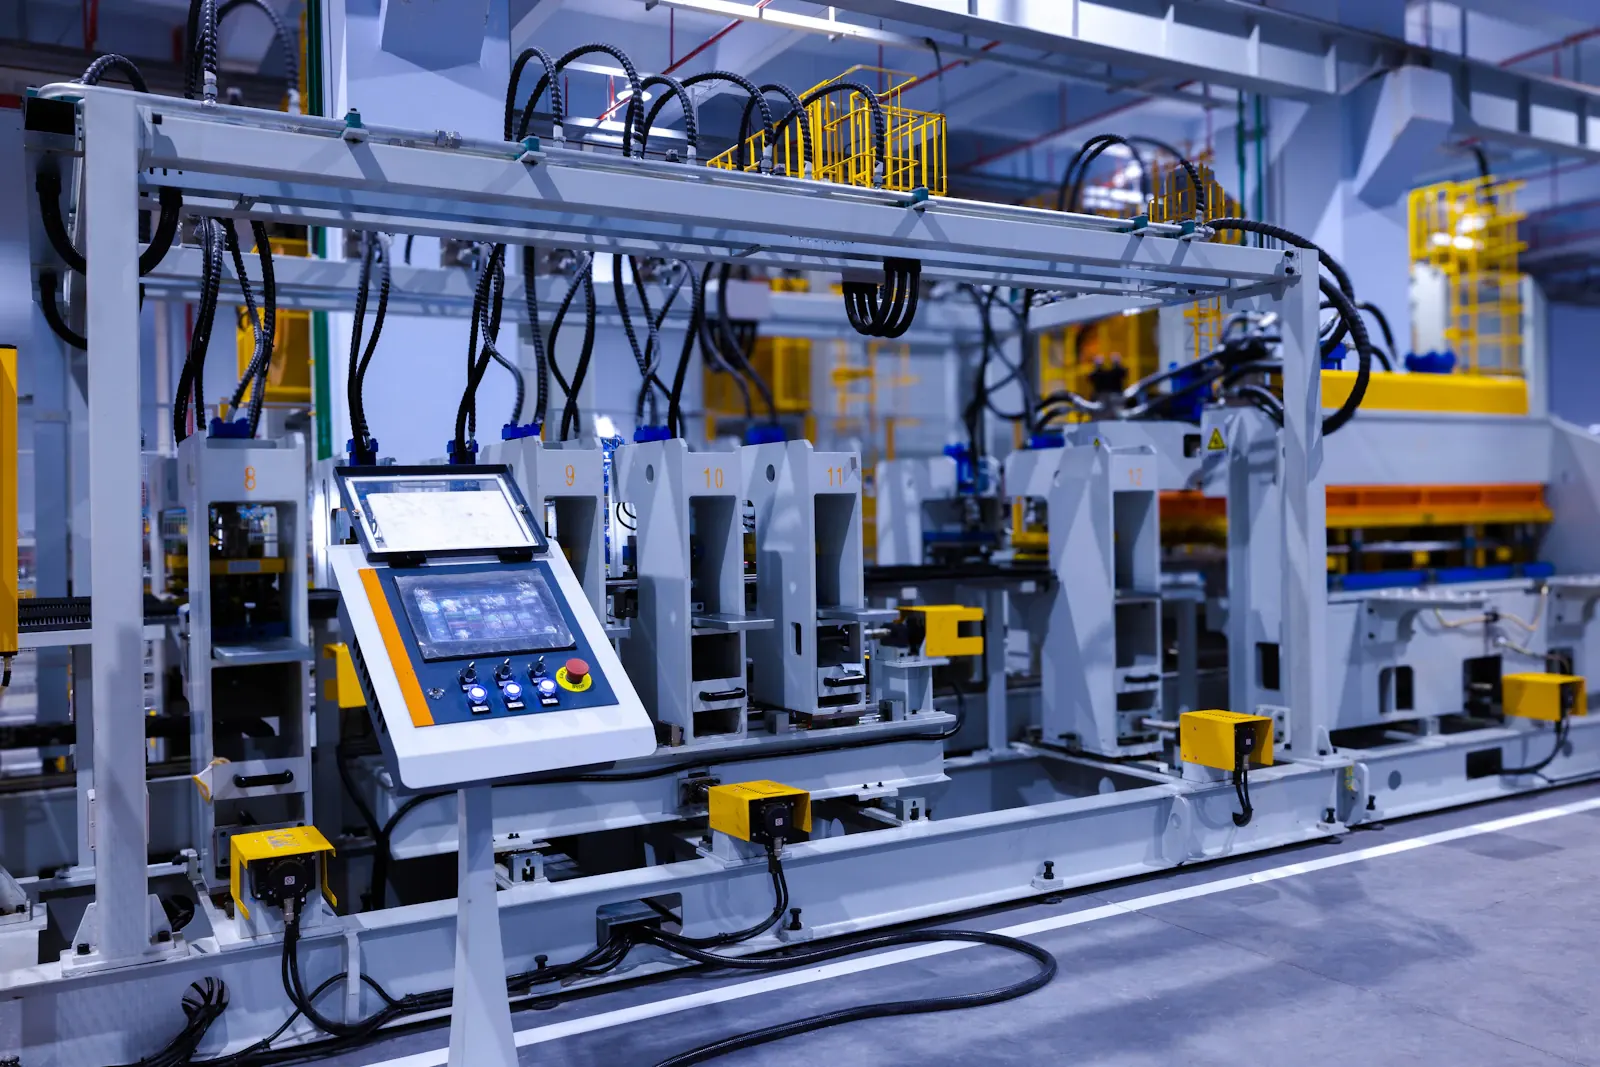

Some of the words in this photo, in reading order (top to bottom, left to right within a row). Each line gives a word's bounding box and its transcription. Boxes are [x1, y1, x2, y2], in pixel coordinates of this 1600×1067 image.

[244, 465, 256, 491] 8
[565, 464, 575, 487] 9
[703, 467, 723, 489] 10
[827, 466, 842, 487] 11
